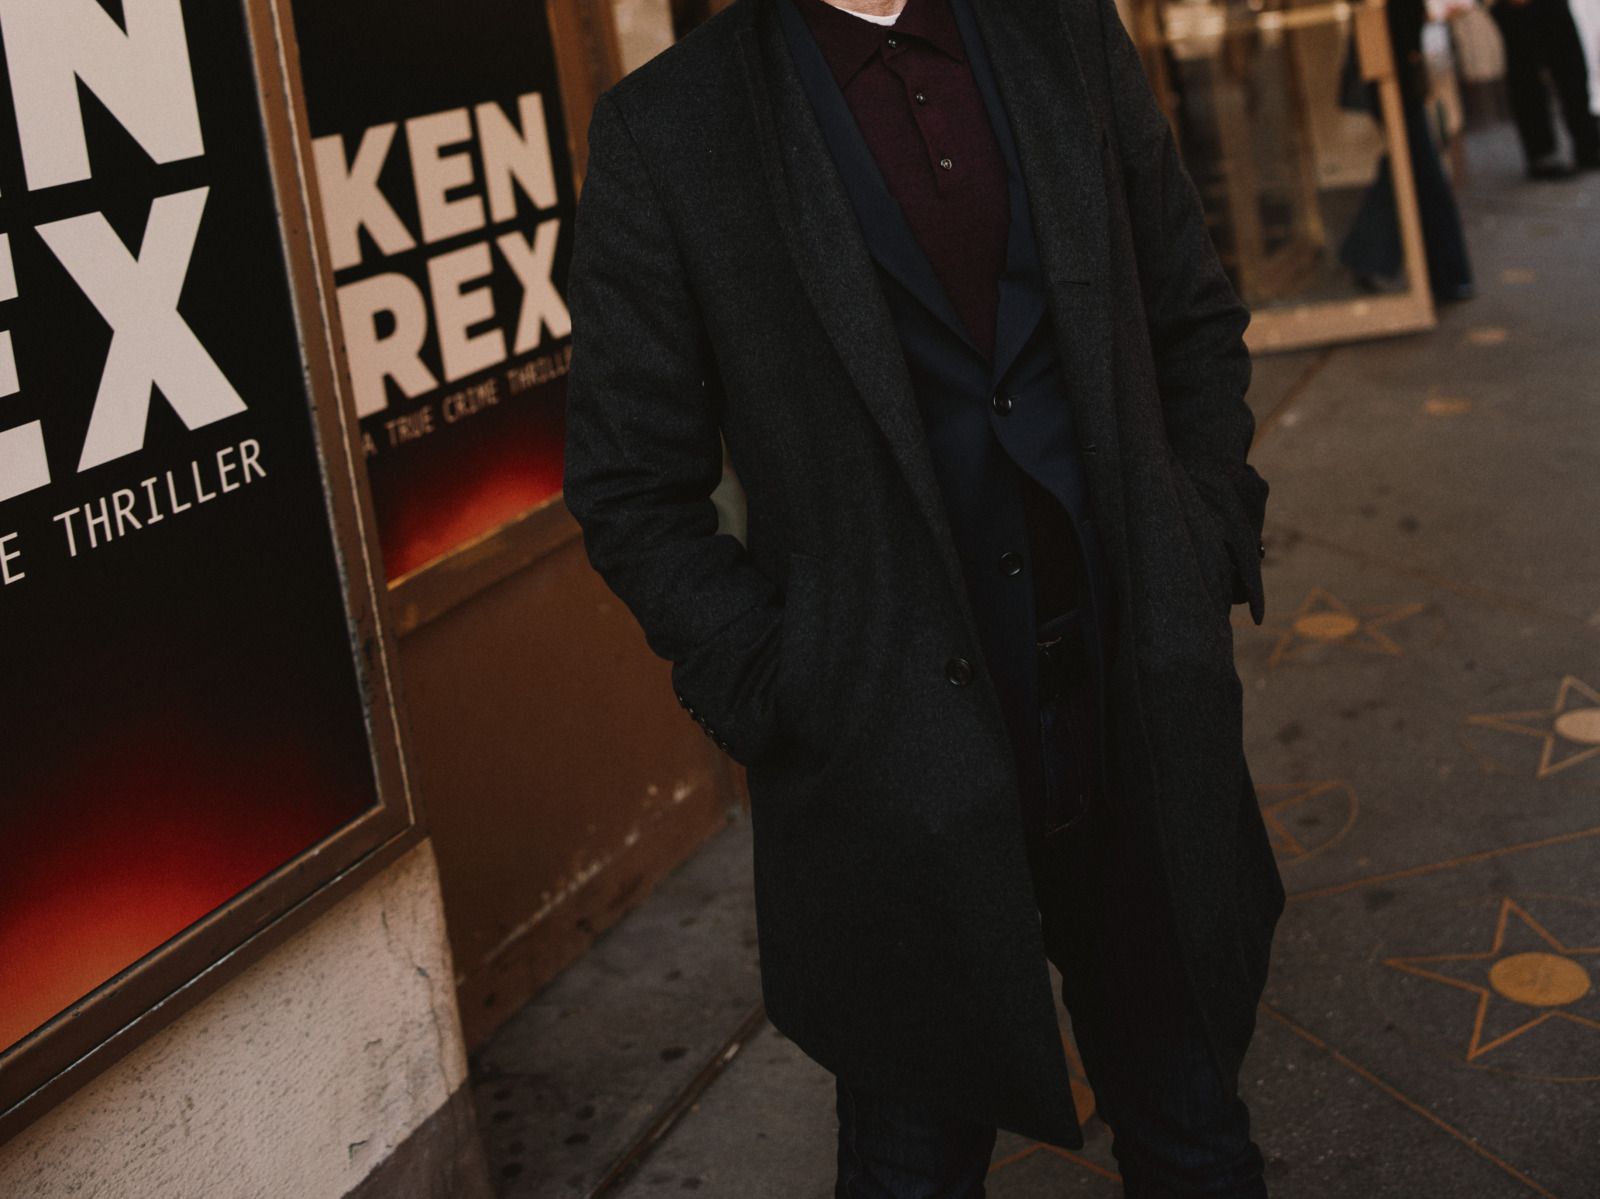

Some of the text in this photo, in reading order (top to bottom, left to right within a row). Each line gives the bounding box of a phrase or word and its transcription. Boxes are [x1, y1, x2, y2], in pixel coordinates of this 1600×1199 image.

[312, 92, 558, 271] KEN
[0, 186, 249, 502] X
[336, 218, 572, 419] REX
[53, 439, 267, 557] THRILLER
[385, 404, 435, 447] TRUE
[441, 377, 499, 424] CRIME
